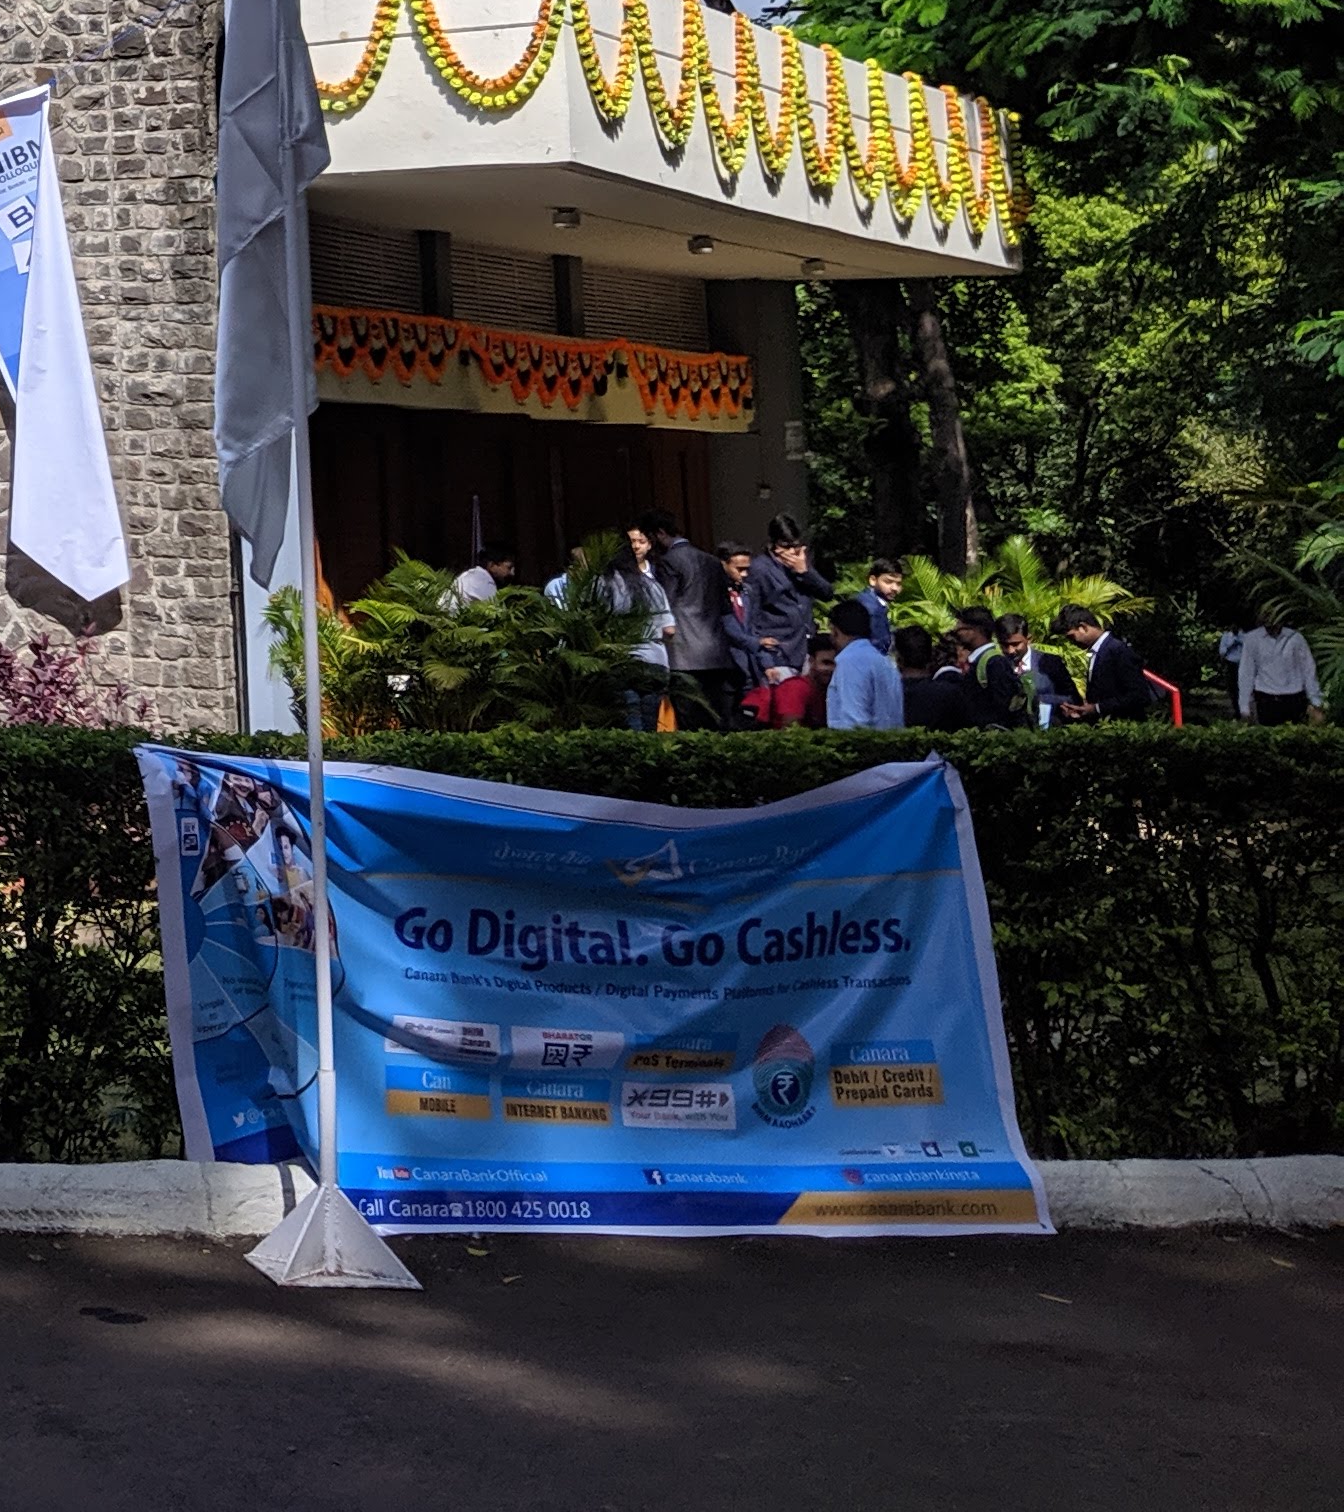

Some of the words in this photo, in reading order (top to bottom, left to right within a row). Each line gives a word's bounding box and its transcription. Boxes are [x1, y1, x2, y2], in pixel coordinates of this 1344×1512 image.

[394, 907, 453, 953] Go
[468, 908, 648, 971] Digital.
[662, 924, 725, 966] Go
[737, 910, 911, 966] Cashless.
[405, 967, 447, 982] Canara
[451, 972, 491, 987] Bank's
[494, 976, 532, 991] Digital
[535, 980, 591, 995] Products
[605, 984, 649, 999] Digital
[654, 986, 719, 1001] Payments
[850, 1045, 910, 1062] Canara
[422, 1071, 451, 1089] Can
[834, 1070, 870, 1084] Debit
[882, 1069, 925, 1083] Credit
[836, 1085, 888, 1101] Prepaid
[893, 1084, 934, 1099] Cards
[506, 1103, 557, 1119] INTERNET
[412, 1167, 548, 1182] CanaraBankOfficial
[666, 1172, 746, 1184] canarabank
[358, 1198, 384, 1217] Call
[389, 1199, 450, 1217] Canara
[466, 1200, 507, 1218] 1800
[511, 1201, 544, 1218] 425
[548, 1201, 591, 1218] 0018
